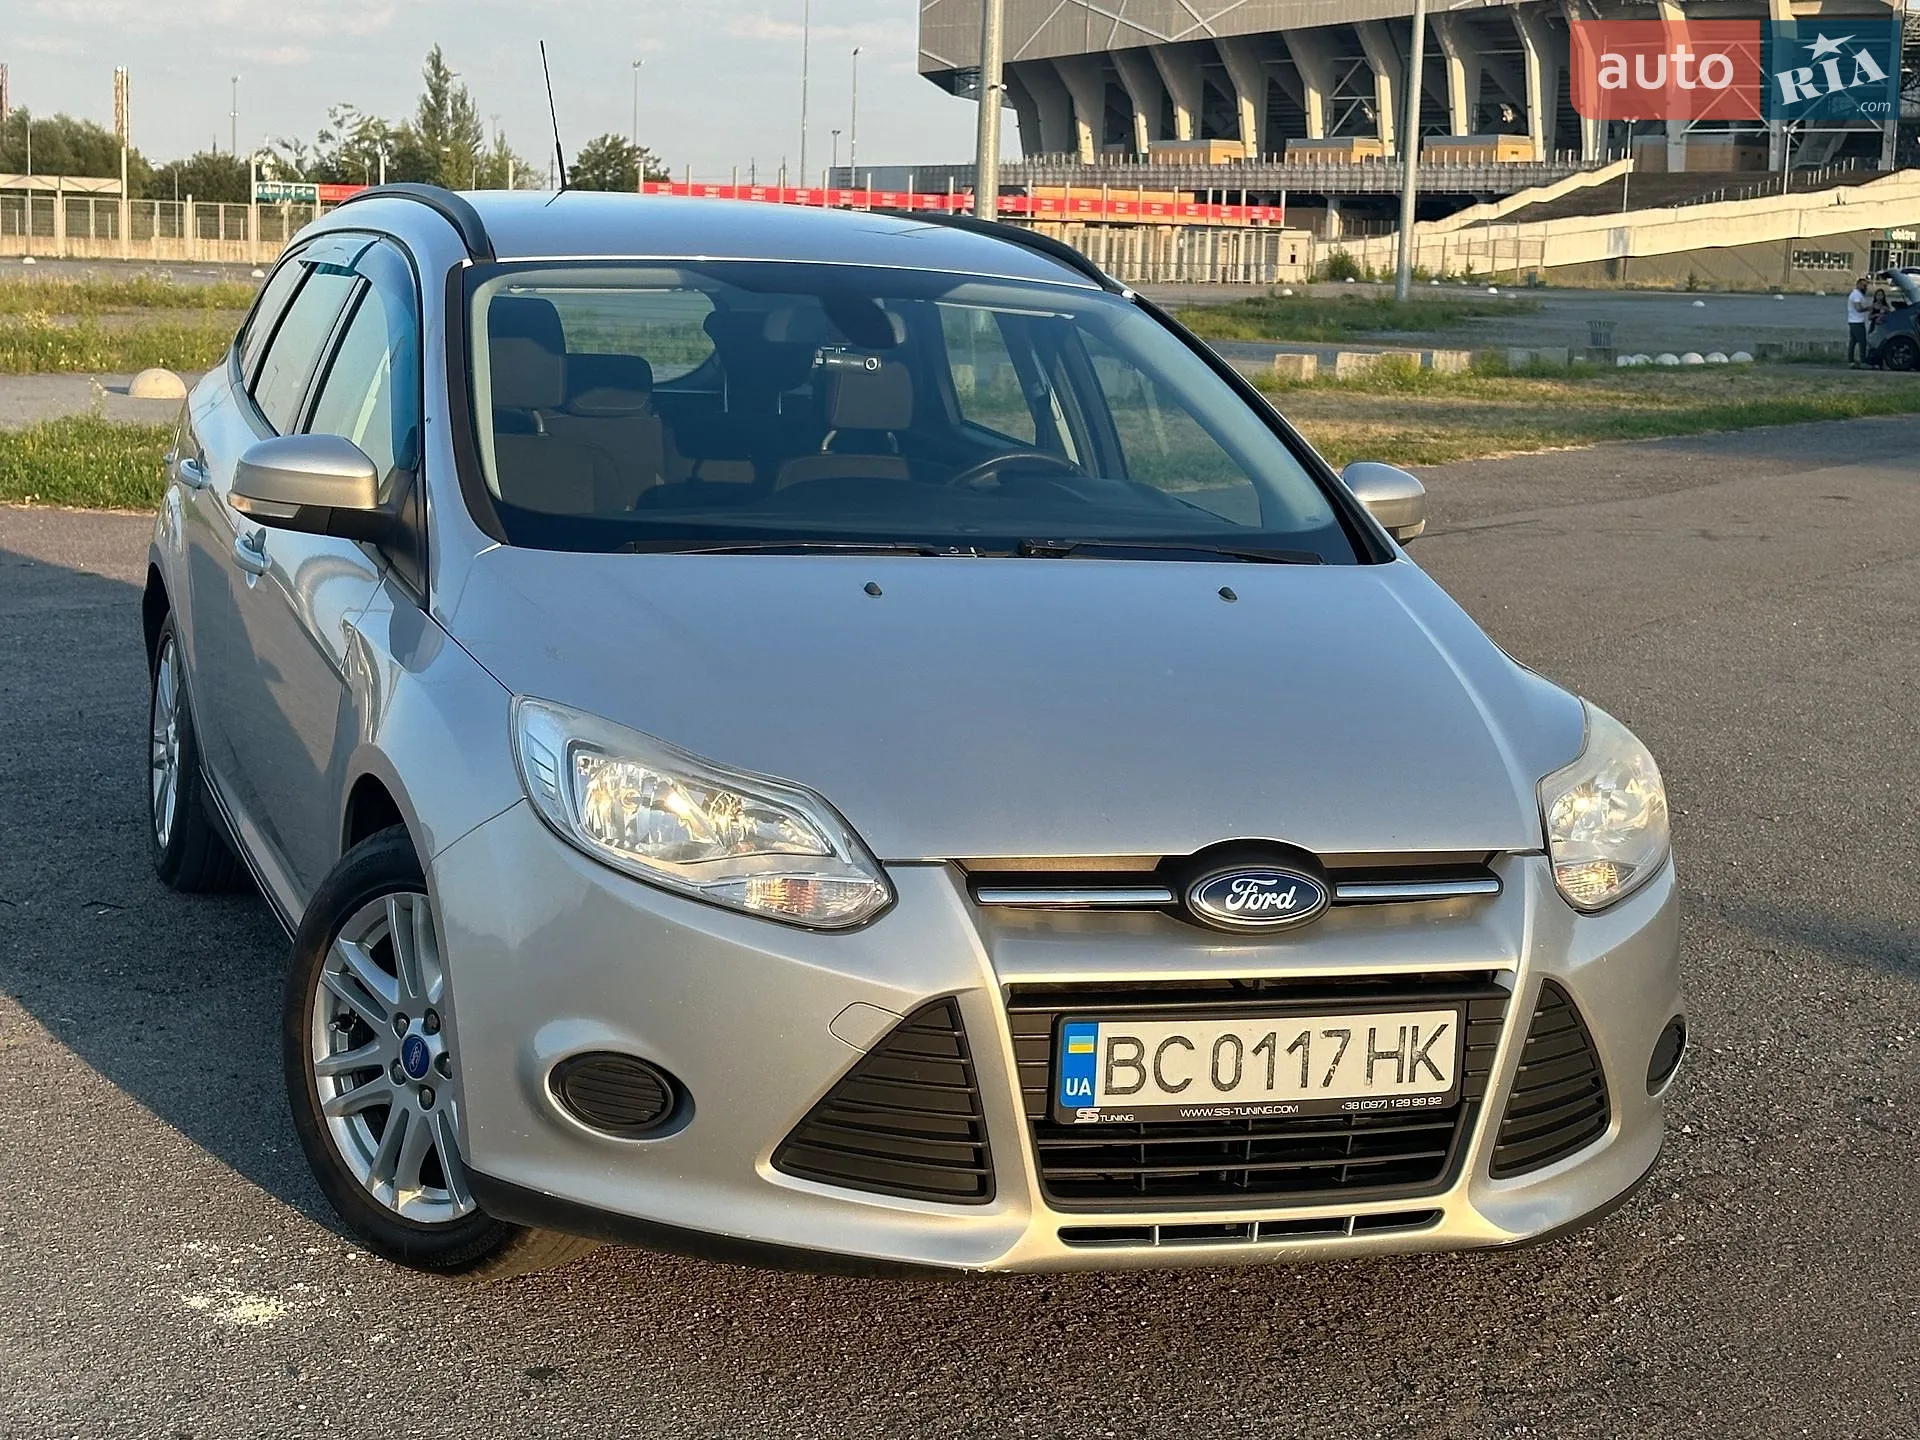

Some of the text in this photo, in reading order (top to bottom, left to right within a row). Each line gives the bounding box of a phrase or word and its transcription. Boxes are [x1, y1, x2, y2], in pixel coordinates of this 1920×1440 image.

[1225, 878, 1297, 911] Ford
[1104, 1024, 1449, 1096] BC 0117 HK
[1066, 1077, 1092, 1097] UA
[1361, 1099, 1388, 1110] (097)
[1390, 1098, 1411, 1108] 129
[1412, 1097, 1427, 1107] 99
[1427, 1096, 1443, 1106] 92
[1074, 1108, 1135, 1123] SS TUNING
